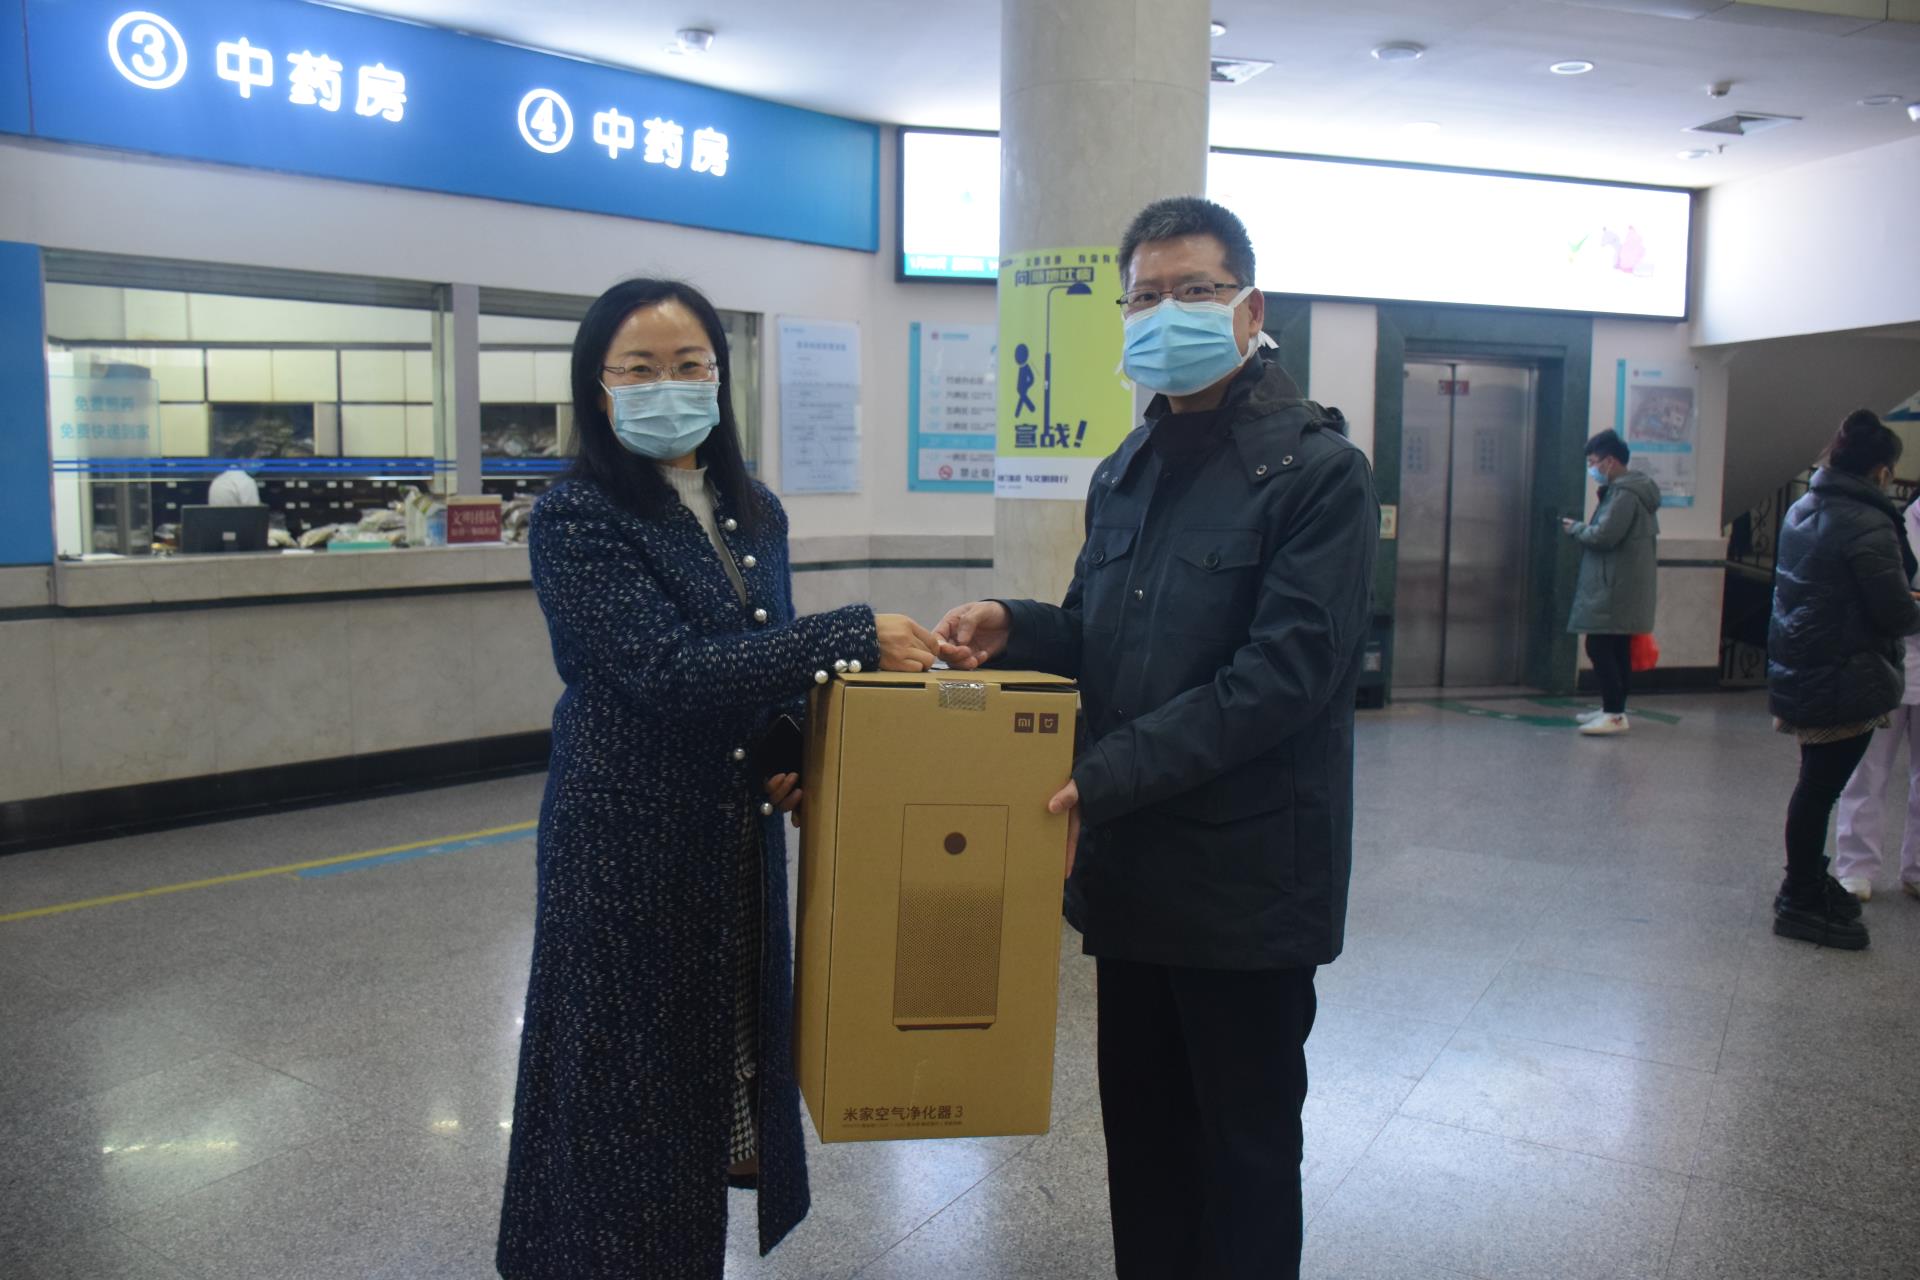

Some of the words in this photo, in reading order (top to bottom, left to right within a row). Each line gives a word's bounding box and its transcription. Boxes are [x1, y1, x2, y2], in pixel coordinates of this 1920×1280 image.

[215, 36, 408, 123] 中药房
[592, 107, 730, 177] 中药房
